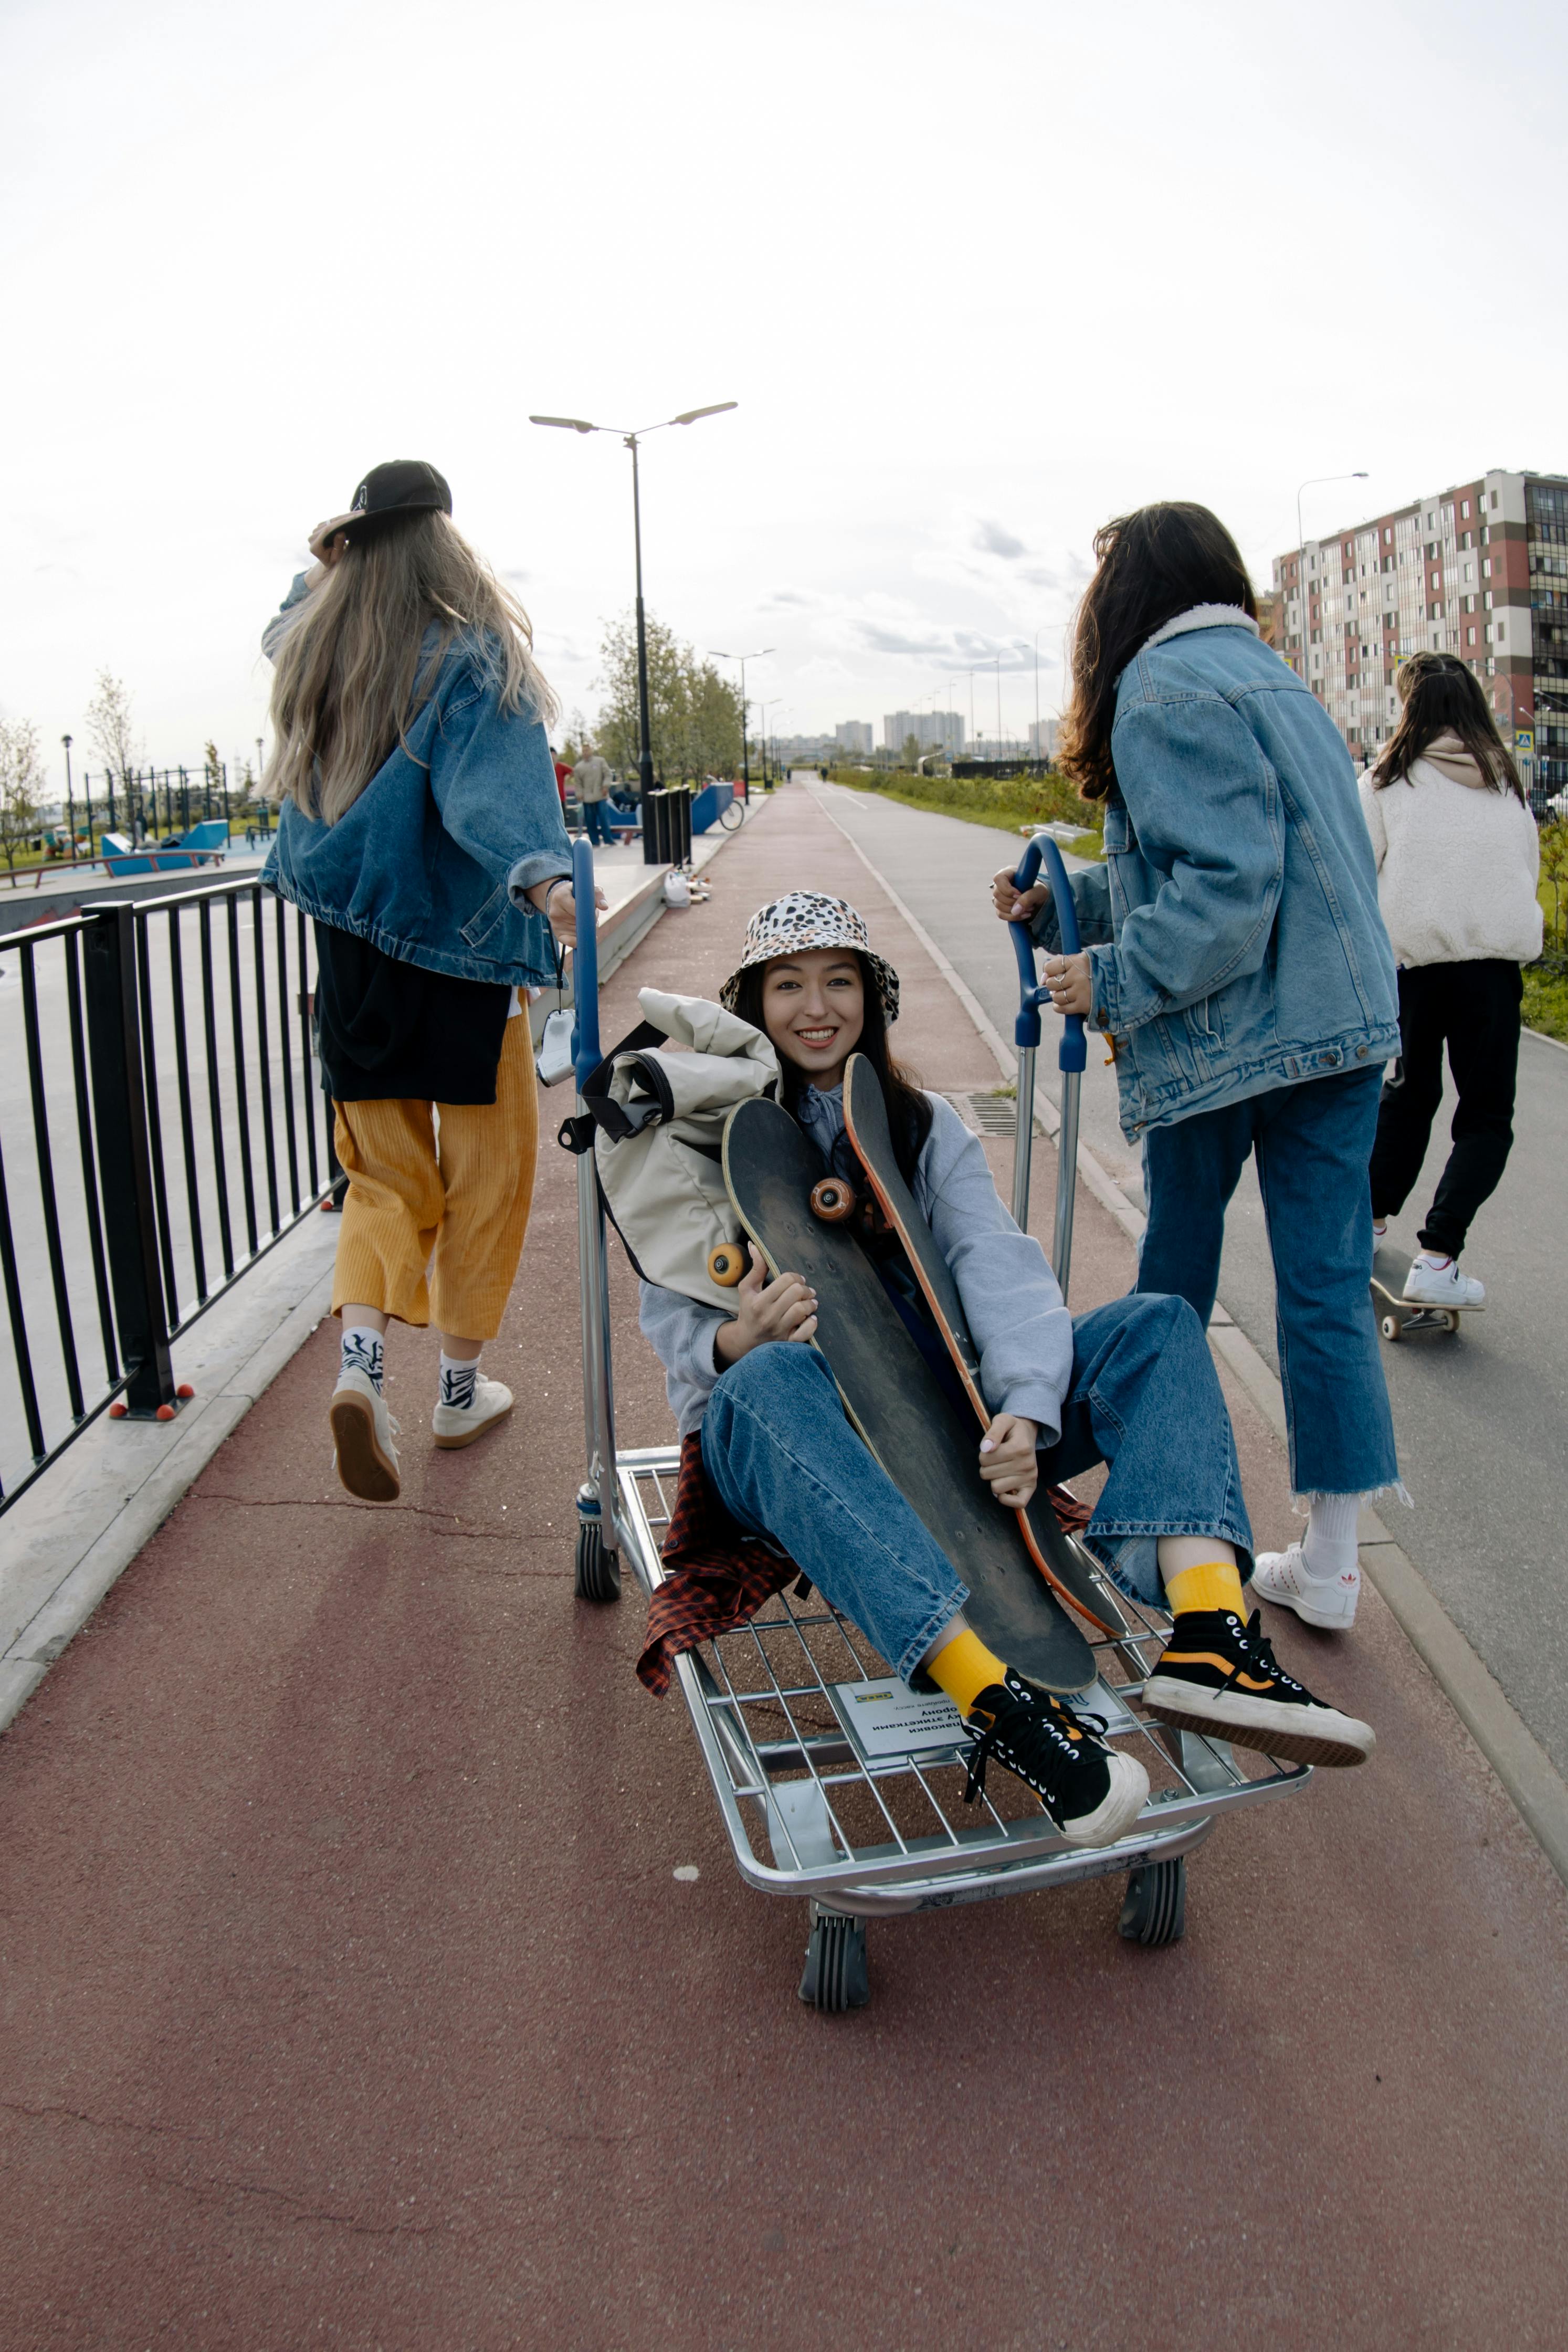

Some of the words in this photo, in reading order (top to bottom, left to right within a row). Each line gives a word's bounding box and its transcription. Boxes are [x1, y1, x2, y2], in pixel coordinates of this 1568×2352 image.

[922, 1707, 957, 1716] орону
[872, 1716, 944, 1731] этикетками
[909, 1722, 961, 1734] паковки
